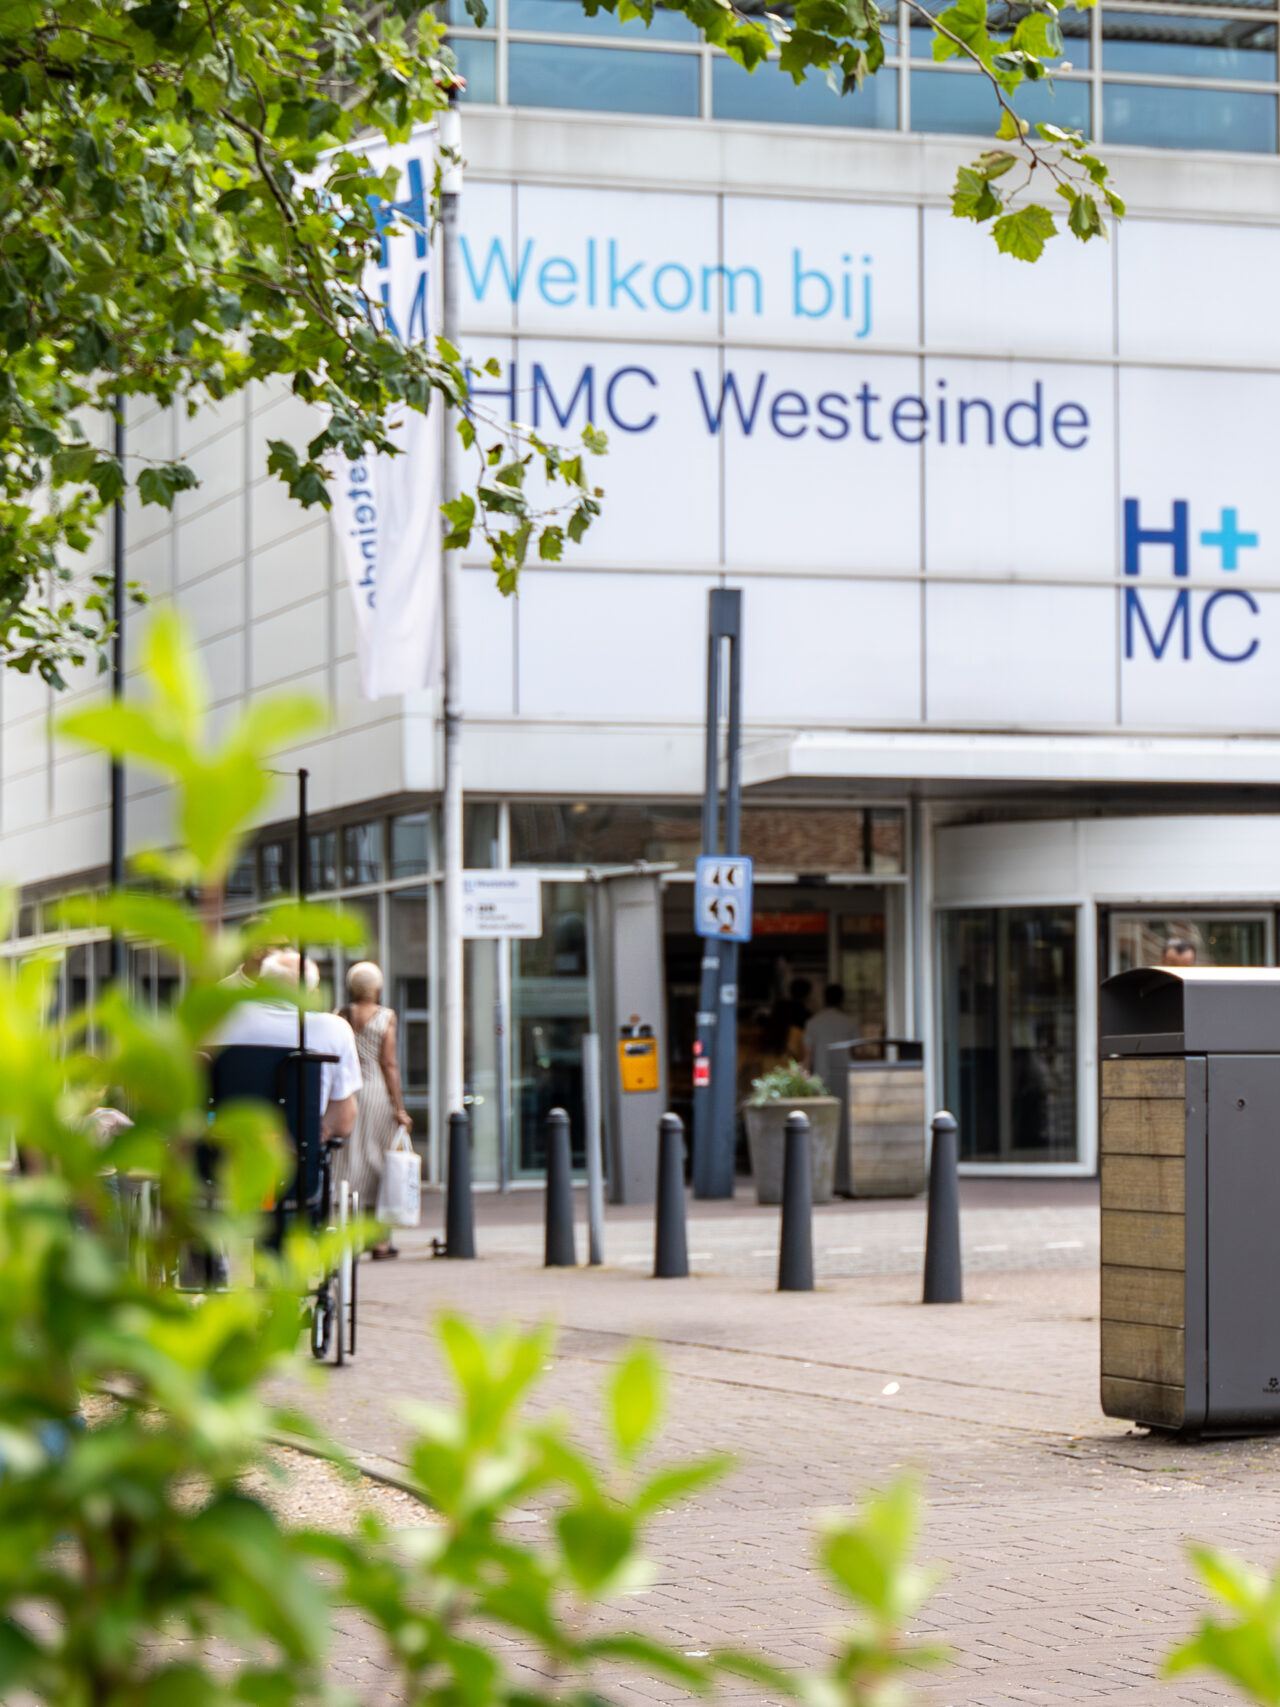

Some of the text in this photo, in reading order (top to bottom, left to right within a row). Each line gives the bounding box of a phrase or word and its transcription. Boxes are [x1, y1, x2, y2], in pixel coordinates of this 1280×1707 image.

[458, 234, 873, 340] Welkom bij
[464, 360, 1091, 449] HMC Westeinde
[1124, 497, 1259, 577] H+
[1125, 585, 1260, 663] MC
